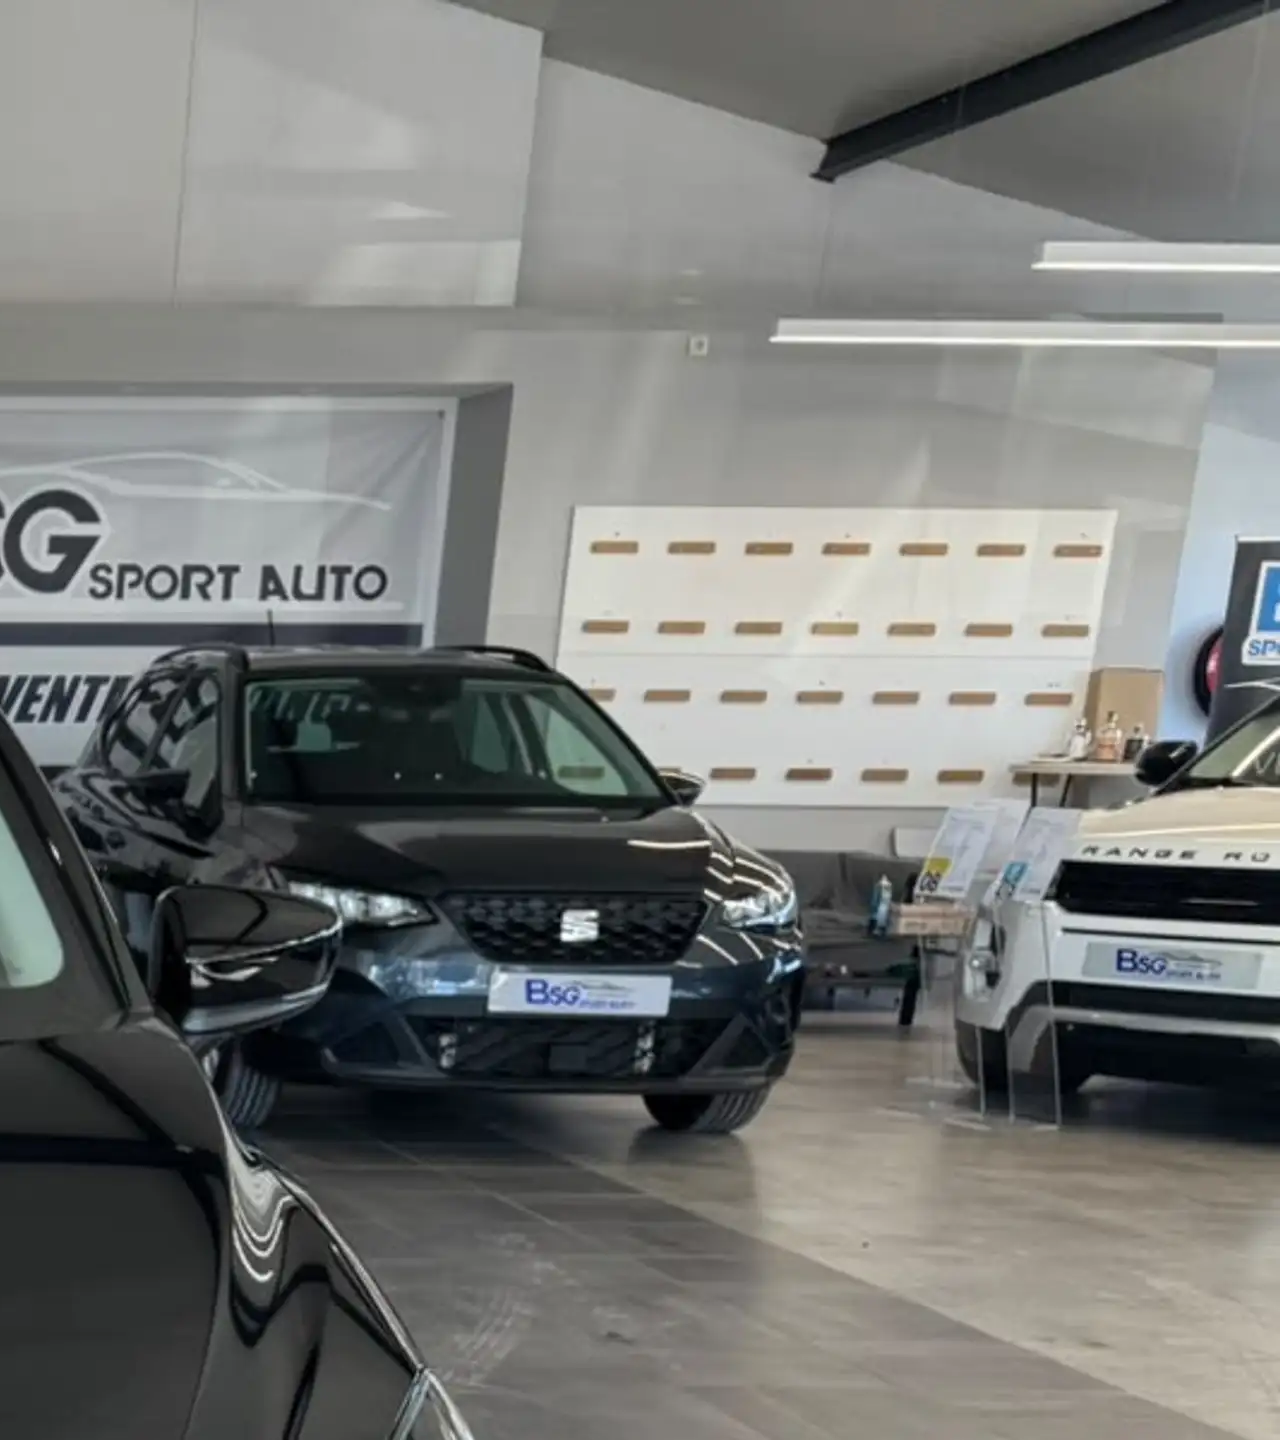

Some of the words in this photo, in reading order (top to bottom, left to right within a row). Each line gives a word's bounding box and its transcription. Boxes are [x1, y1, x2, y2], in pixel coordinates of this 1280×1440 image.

[88, 563, 241, 600] SPORT
[257, 564, 389, 601] AUTO
[1248, 638, 1280, 658] SP
[1080, 845, 1199, 861] RANGE
[1116, 948, 1168, 976] BSG
[524, 978, 581, 1006] BSG
